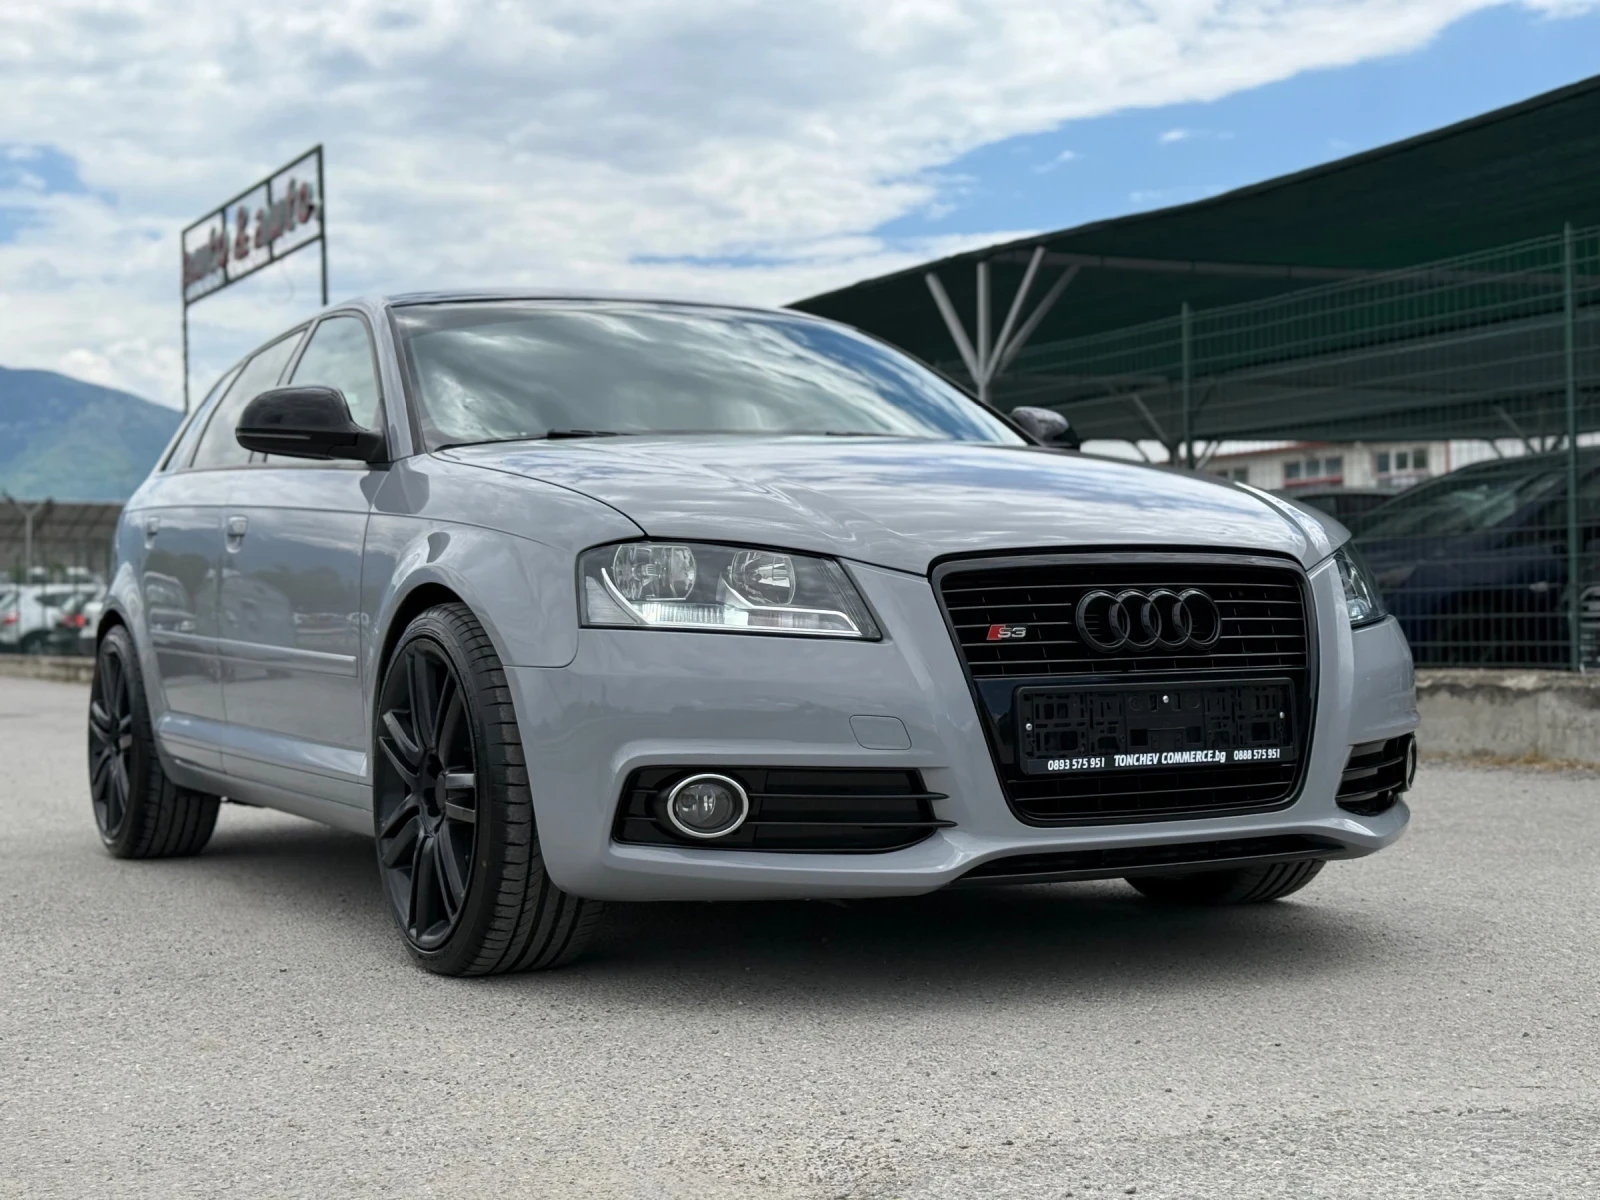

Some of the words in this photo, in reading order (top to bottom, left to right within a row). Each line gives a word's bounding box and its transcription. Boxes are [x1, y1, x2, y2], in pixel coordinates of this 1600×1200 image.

[998, 627, 1026, 638] S3
[1047, 759, 1070, 770] 0893
[1072, 758, 1088, 769] 575
[1090, 757, 1105, 768] 951
[1113, 752, 1159, 767] TONCHEV
[1161, 750, 1227, 764] COMMERCE.bg
[1233, 749, 1252, 760] 0888
[1253, 748, 1267, 759] 575
[1268, 748, 1281, 758] 951
